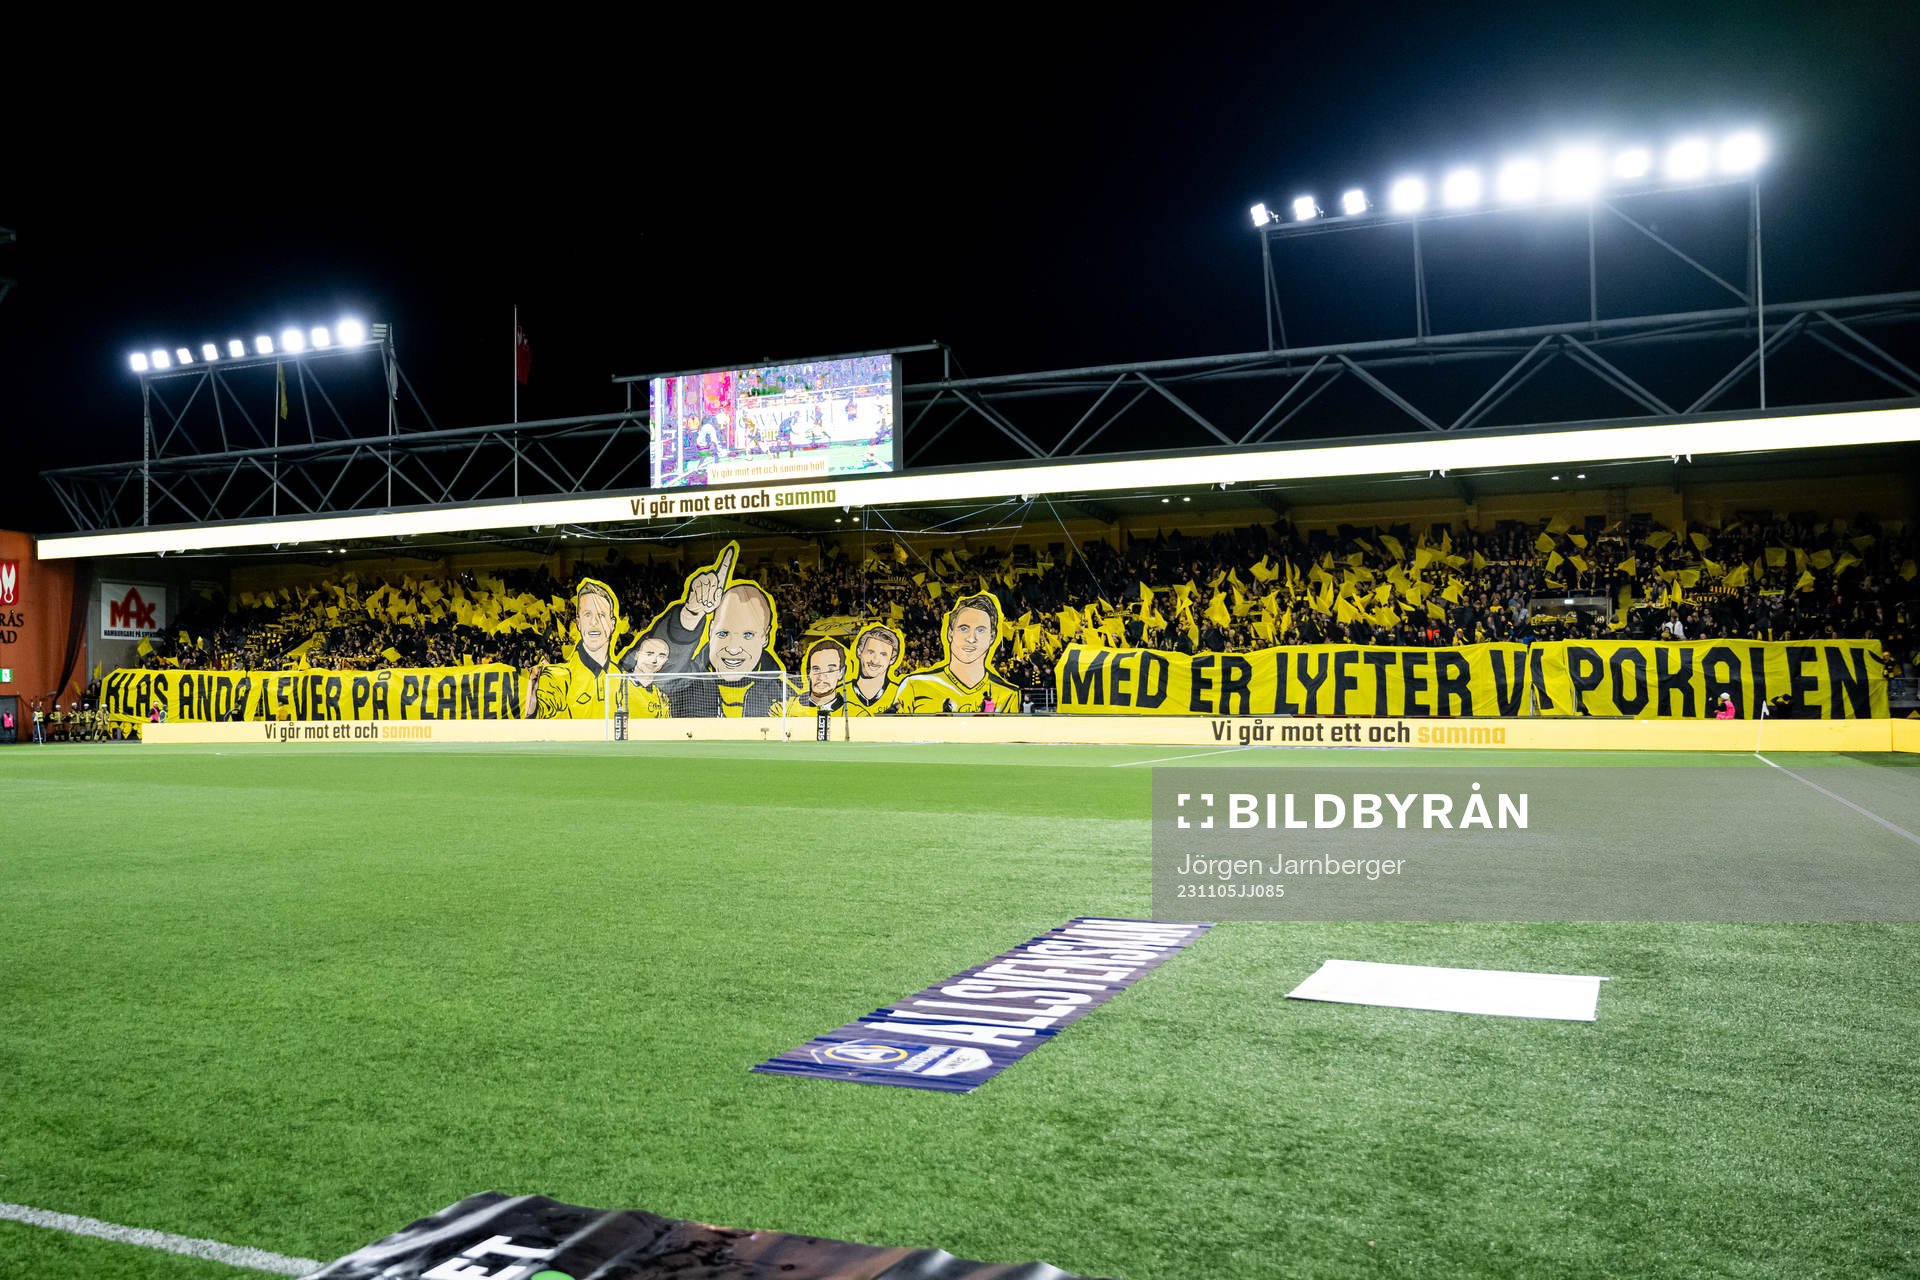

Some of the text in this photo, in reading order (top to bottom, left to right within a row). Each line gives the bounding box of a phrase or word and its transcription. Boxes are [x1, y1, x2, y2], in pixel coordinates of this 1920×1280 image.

[631, 489, 836, 518] Vi går mot ett och samma
[110, 587, 157, 629] MAX
[352, 671, 392, 721] PÅ
[401, 671, 521, 720] PLANEN
[1061, 649, 1170, 709] MED
[1189, 655, 1252, 715] ER
[1275, 650, 1473, 716] LYFTER
[1567, 646, 1872, 720] POKALEN
[265, 722, 432, 741] Vi går mot ett och samma
[818, 715, 826, 741] SELECT
[1212, 719, 1506, 745] Vi går mot ett och samma
[864, 919, 1199, 1048] ALLSVENSKAN
